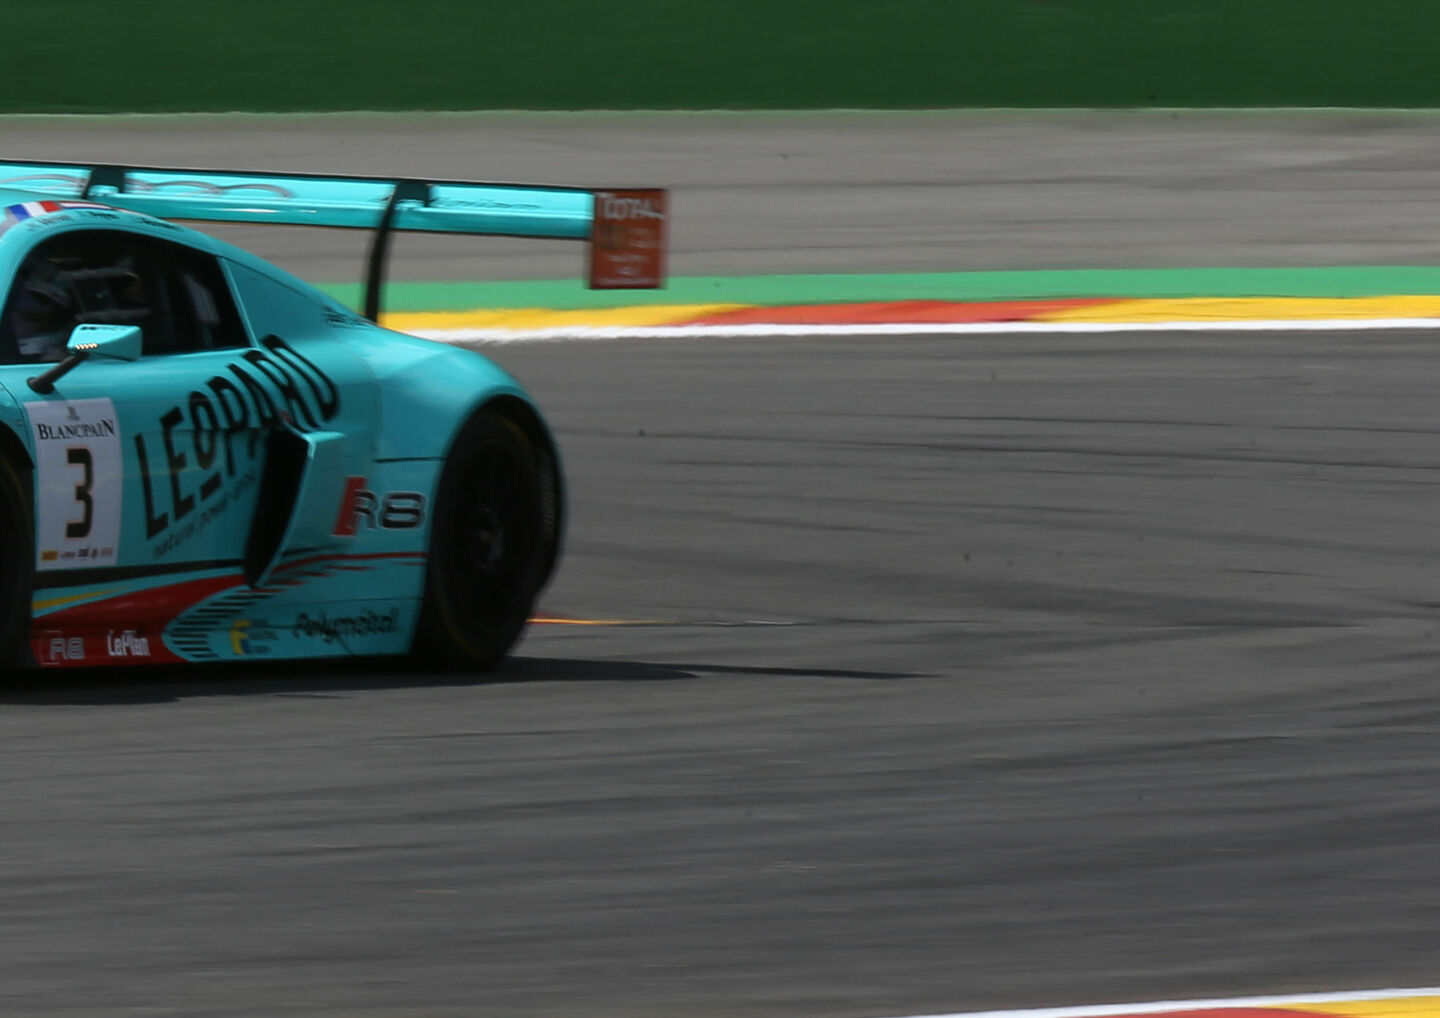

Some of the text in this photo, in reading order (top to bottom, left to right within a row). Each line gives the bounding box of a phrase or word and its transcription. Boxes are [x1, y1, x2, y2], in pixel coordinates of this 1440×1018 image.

[37, 418, 115, 440] BLANCPAIN
[134, 334, 341, 540] LEOPARD
[66, 447, 94, 538] 3
[330, 475, 428, 538] R8
